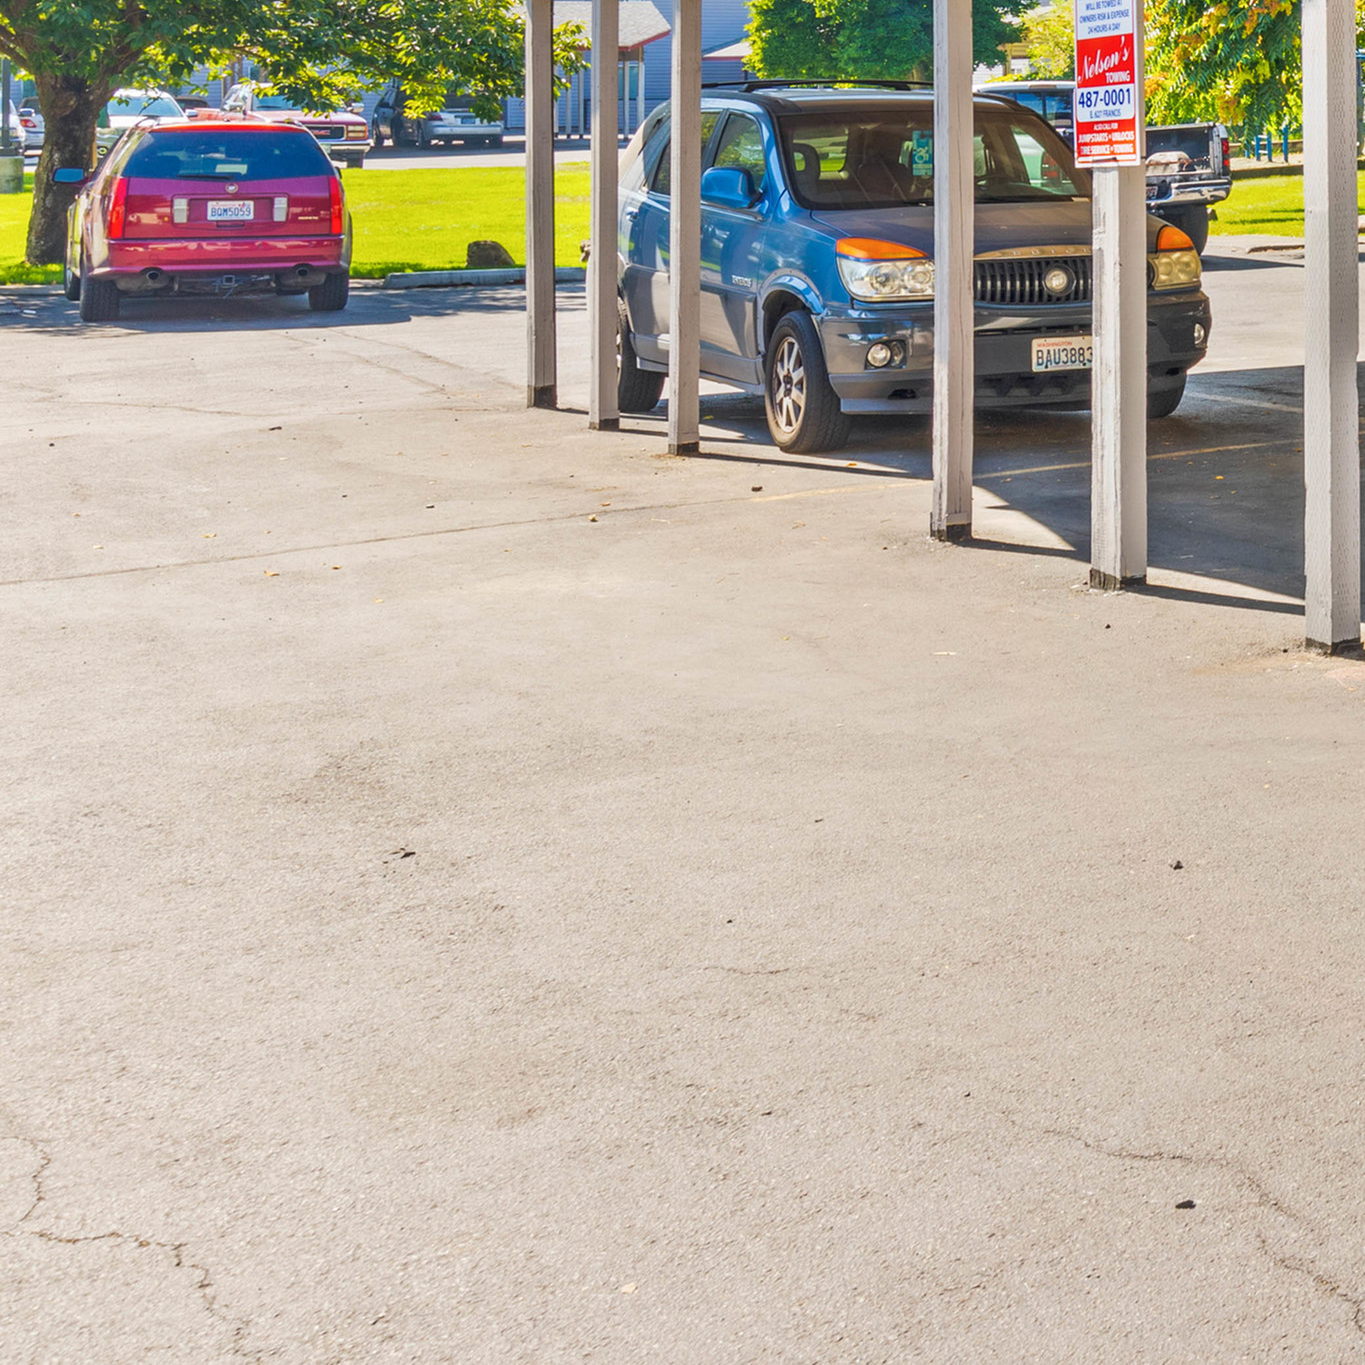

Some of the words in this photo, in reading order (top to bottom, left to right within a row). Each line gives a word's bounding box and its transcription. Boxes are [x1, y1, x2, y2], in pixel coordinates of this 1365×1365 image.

[1086, 2, 1095, 11] WILL
[1096, 1, 1101, 9] BE
[1080, 13, 1097, 23] OWNERS
[1097, 12, 1106, 21] RISK
[1111, 8, 1130, 19] EXPENSE
[1088, 25, 1094, 34] 24
[1094, 23, 1107, 33] HOURS
[1112, 21, 1121, 31] DAY
[1078, 35, 1131, 84] Nelson's
[1105, 70, 1131, 83] TOWING
[1078, 88, 1131, 108] 487-0001
[1103, 108, 1121, 117] FRANCIS
[1078, 133, 1108, 143] JUMPSTARTS
[1111, 131, 1134, 141] UNLOCKS
[1090, 144, 1110, 154] SERVICE
[1113, 143, 1134, 153] TOWING
[210, 206, 251, 217] BQM5059
[1036, 340, 1073, 348] WASHINGTON
[1036, 346, 1093, 367] BAU3883
